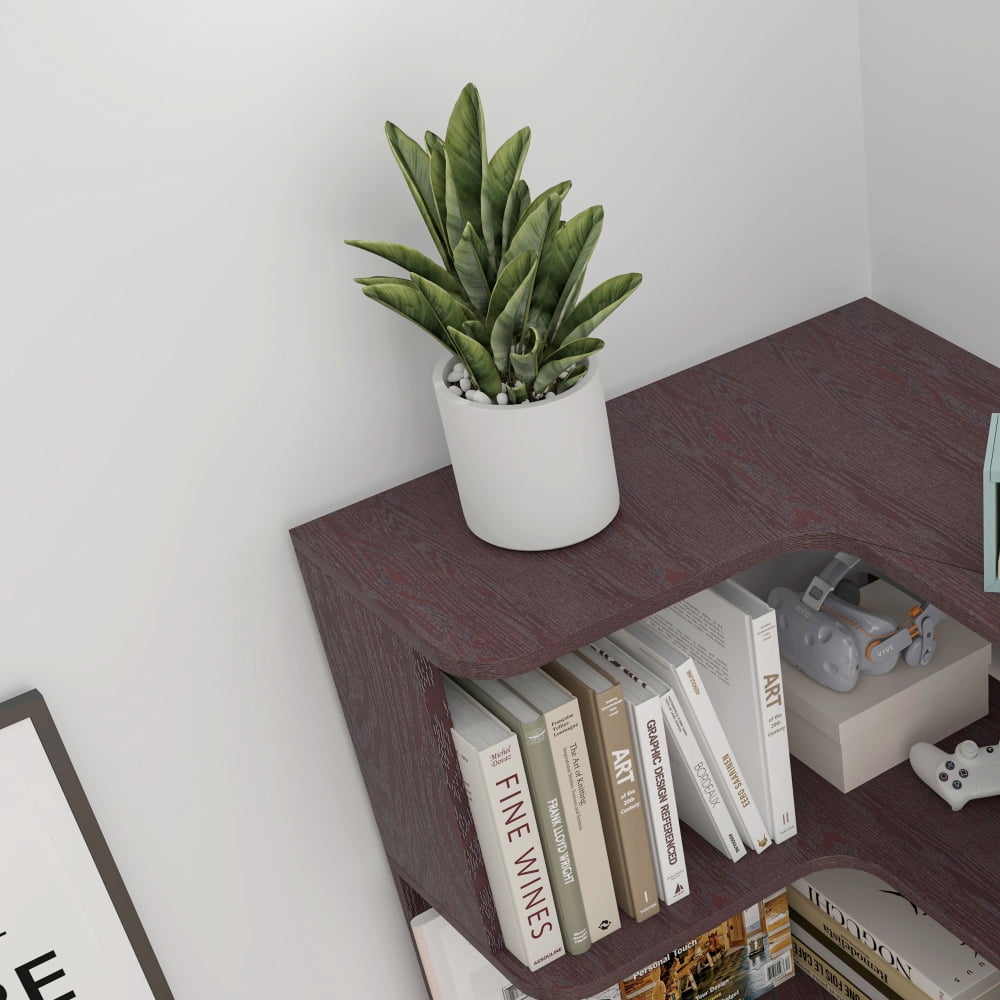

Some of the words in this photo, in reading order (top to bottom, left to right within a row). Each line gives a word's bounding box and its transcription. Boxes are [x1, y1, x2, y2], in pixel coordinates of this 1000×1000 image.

[763, 673, 782, 708] ART
[570, 741, 578, 757] The
[647, 718, 661, 766] GRAPHIC
[572, 757, 580, 769] Art
[575, 769, 582, 777] of
[611, 748, 635, 785] ART
[721, 752, 743, 791] SAARINEN
[577, 777, 587, 807] Knitting
[654, 766, 667, 804] DESIGN
[694, 761, 721, 809] BORDEAUX
[738, 788, 750, 809] EERO
[547, 798, 562, 827] FRANK
[620, 801, 641, 815] Century
[553, 824, 568, 853] LLOYD
[660, 803, 678, 866] REFERENCED
[495, 773, 531, 843] FINE
[514, 846, 553, 940] WINES
[560, 850, 574, 885] WRIGHT
[808, 885, 912, 981] NOGUCHI
[533, 946, 563, 967] ASSOULINE
[632, 953, 671, 981] Personal
[672, 938, 698, 957] Touch
[814, 962, 824, 975] LE
[823, 924, 889, 985] Remodelista
[709, 978, 730, 994] Design
[825, 969, 843, 992] FOIS
